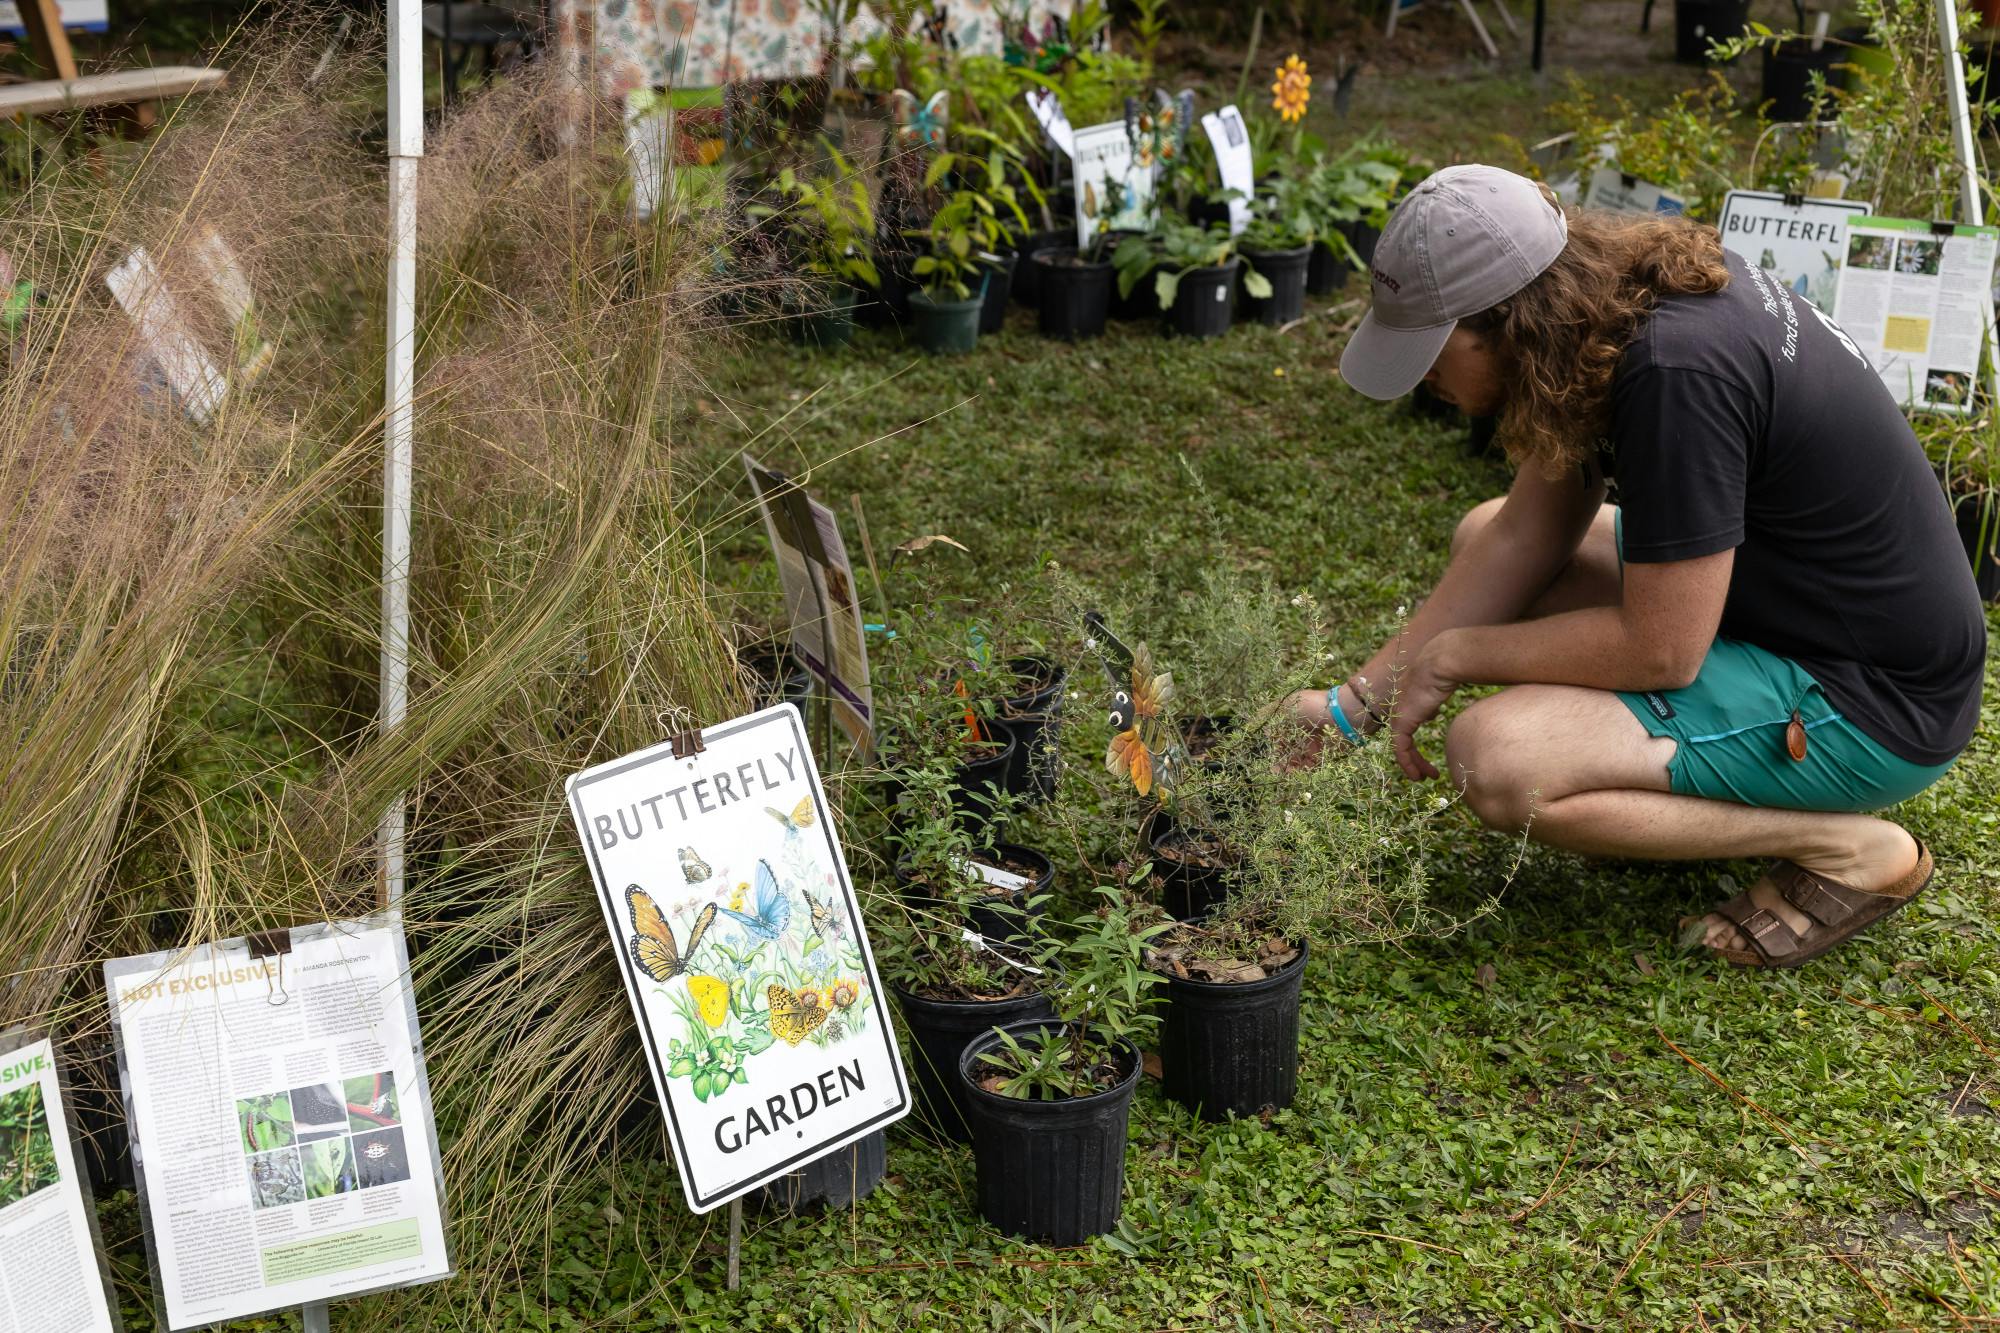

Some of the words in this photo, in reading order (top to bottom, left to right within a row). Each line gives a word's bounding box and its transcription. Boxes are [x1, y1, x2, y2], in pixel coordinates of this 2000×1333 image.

[1728, 213, 1839, 244] BUTTERFL
[1780, 297, 1798, 327] snake
[1782, 322, 1799, 362] fund
[594, 748, 797, 852] BUTTERFLY
[302, 962, 328, 972] AMANDA
[345, 955, 371, 964] NEWTON
[122, 981, 164, 1003] NOT
[169, 962, 278, 995] EXCLUSIVE
[0, 1056, 51, 1083] SIVE,
[714, 1058, 866, 1155] GARDEN
